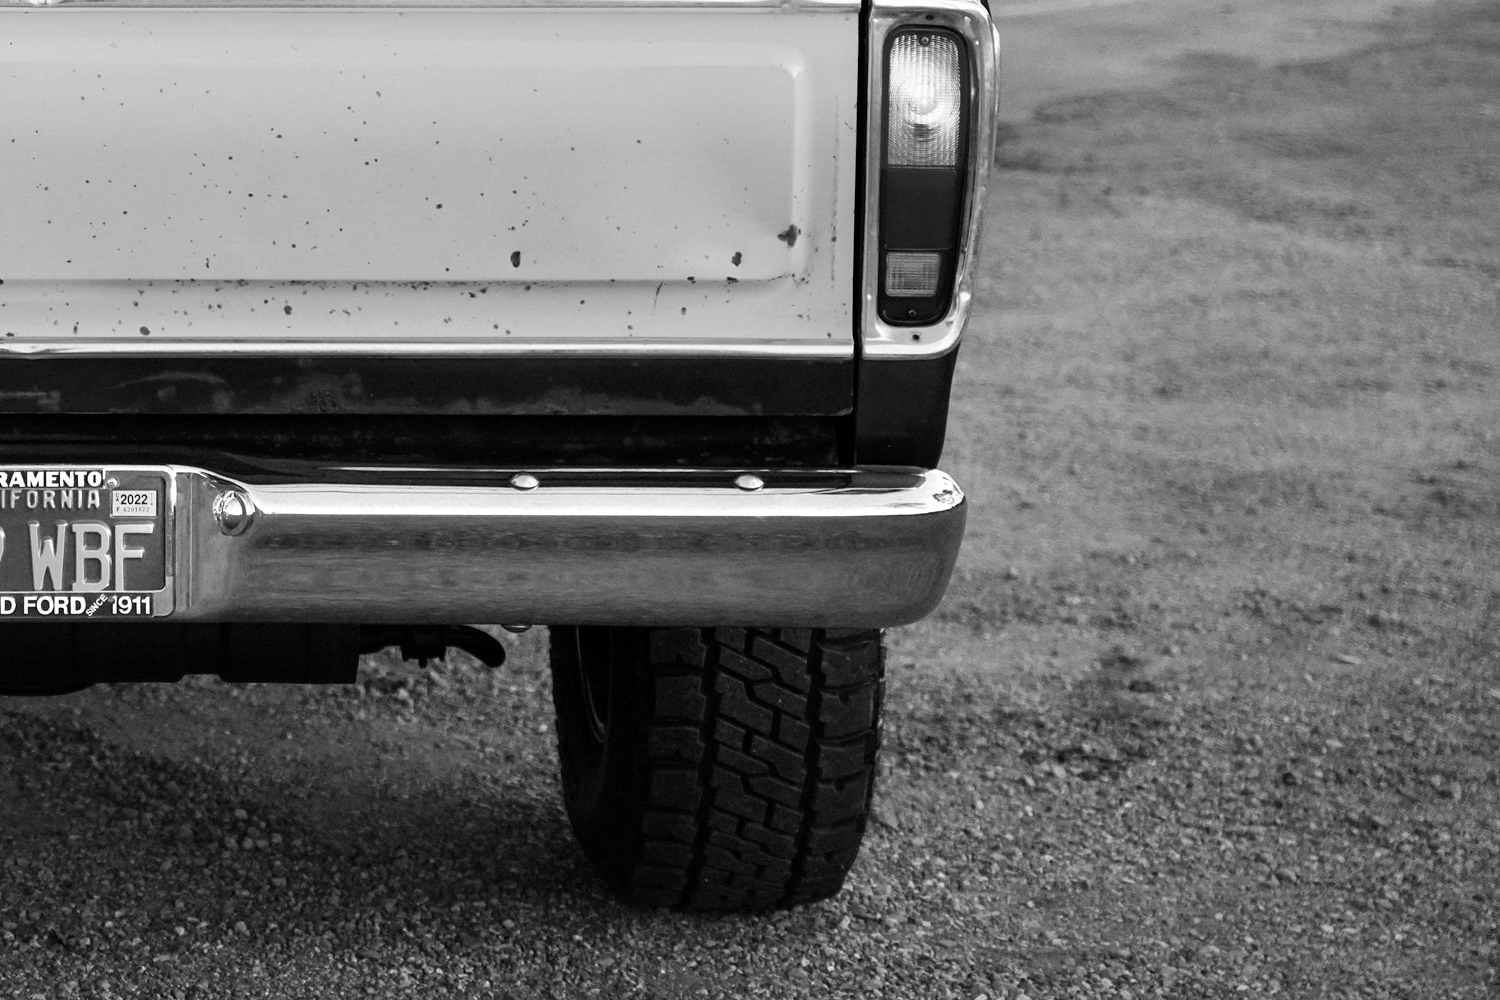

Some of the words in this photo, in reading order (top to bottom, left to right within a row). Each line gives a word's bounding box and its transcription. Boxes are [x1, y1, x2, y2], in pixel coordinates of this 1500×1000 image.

[120, 493, 148, 505] 2022
[28, 521, 155, 592] WBF
[23, 595, 86, 615] FORD
[85, 593, 108, 617] SINCE
[111, 596, 151, 615] 1911
